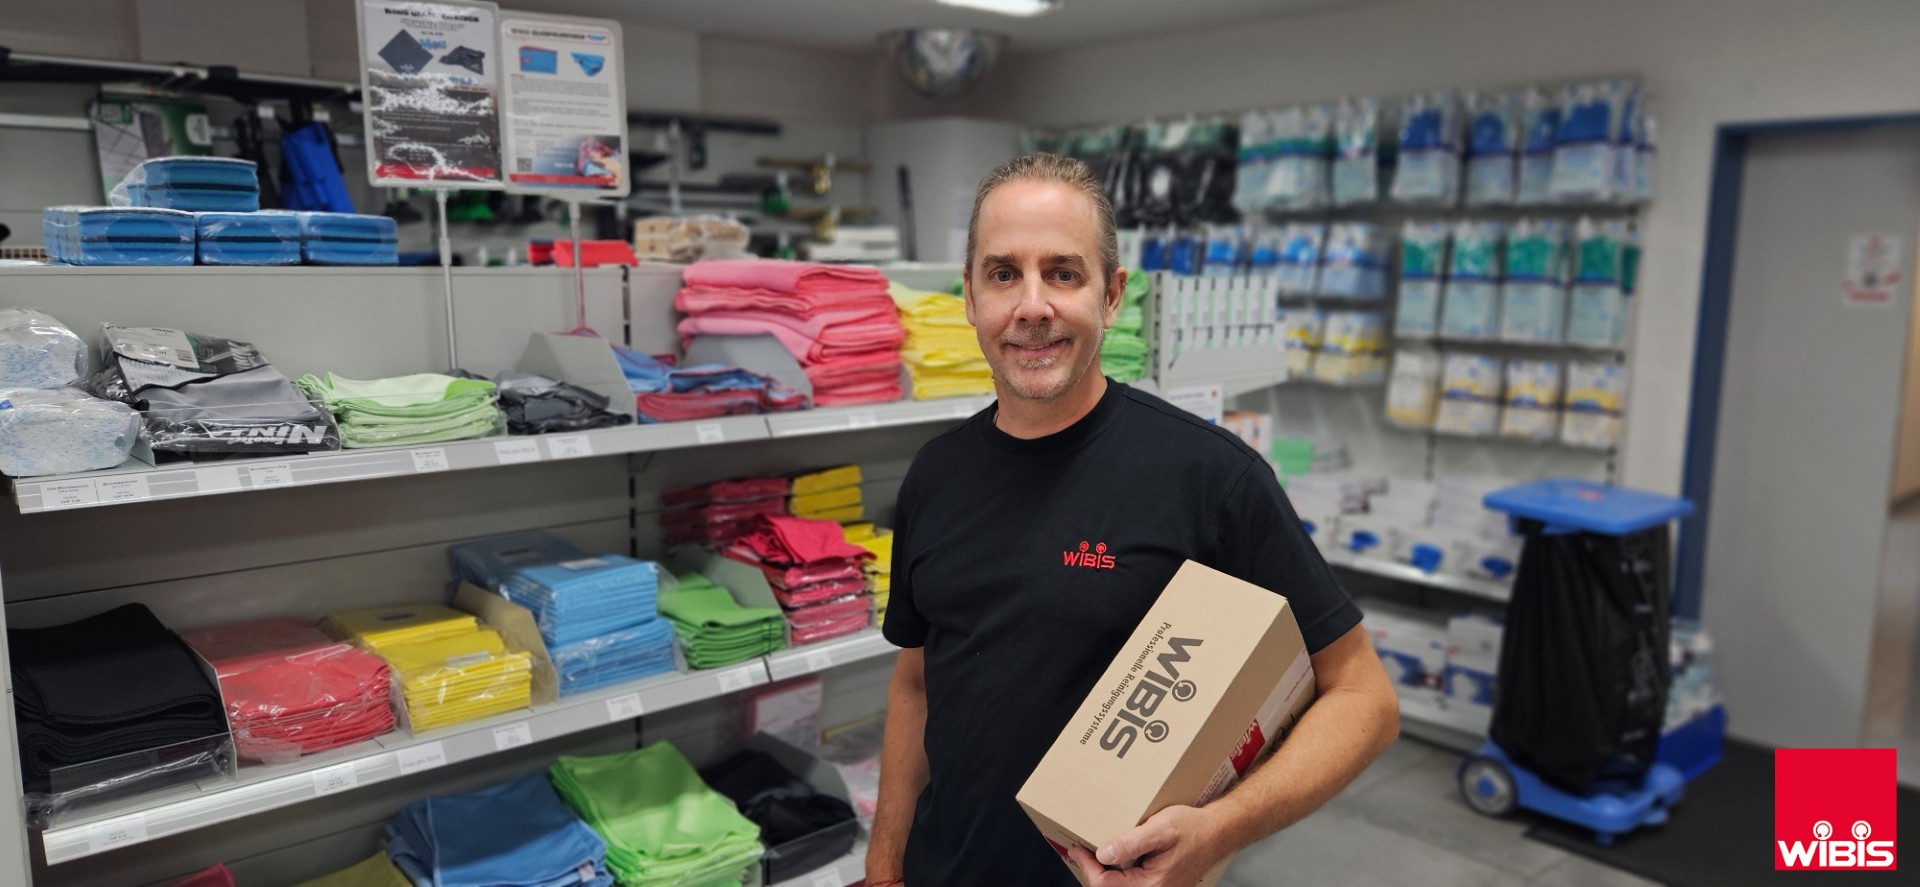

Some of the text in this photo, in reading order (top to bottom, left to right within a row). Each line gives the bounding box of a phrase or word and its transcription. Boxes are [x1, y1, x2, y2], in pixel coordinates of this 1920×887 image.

[1063, 540, 1116, 569] WIBIS
[1080, 621, 1172, 745] Professionelle Reinigungssysteme
[1099, 636, 1204, 759] WIBIS
